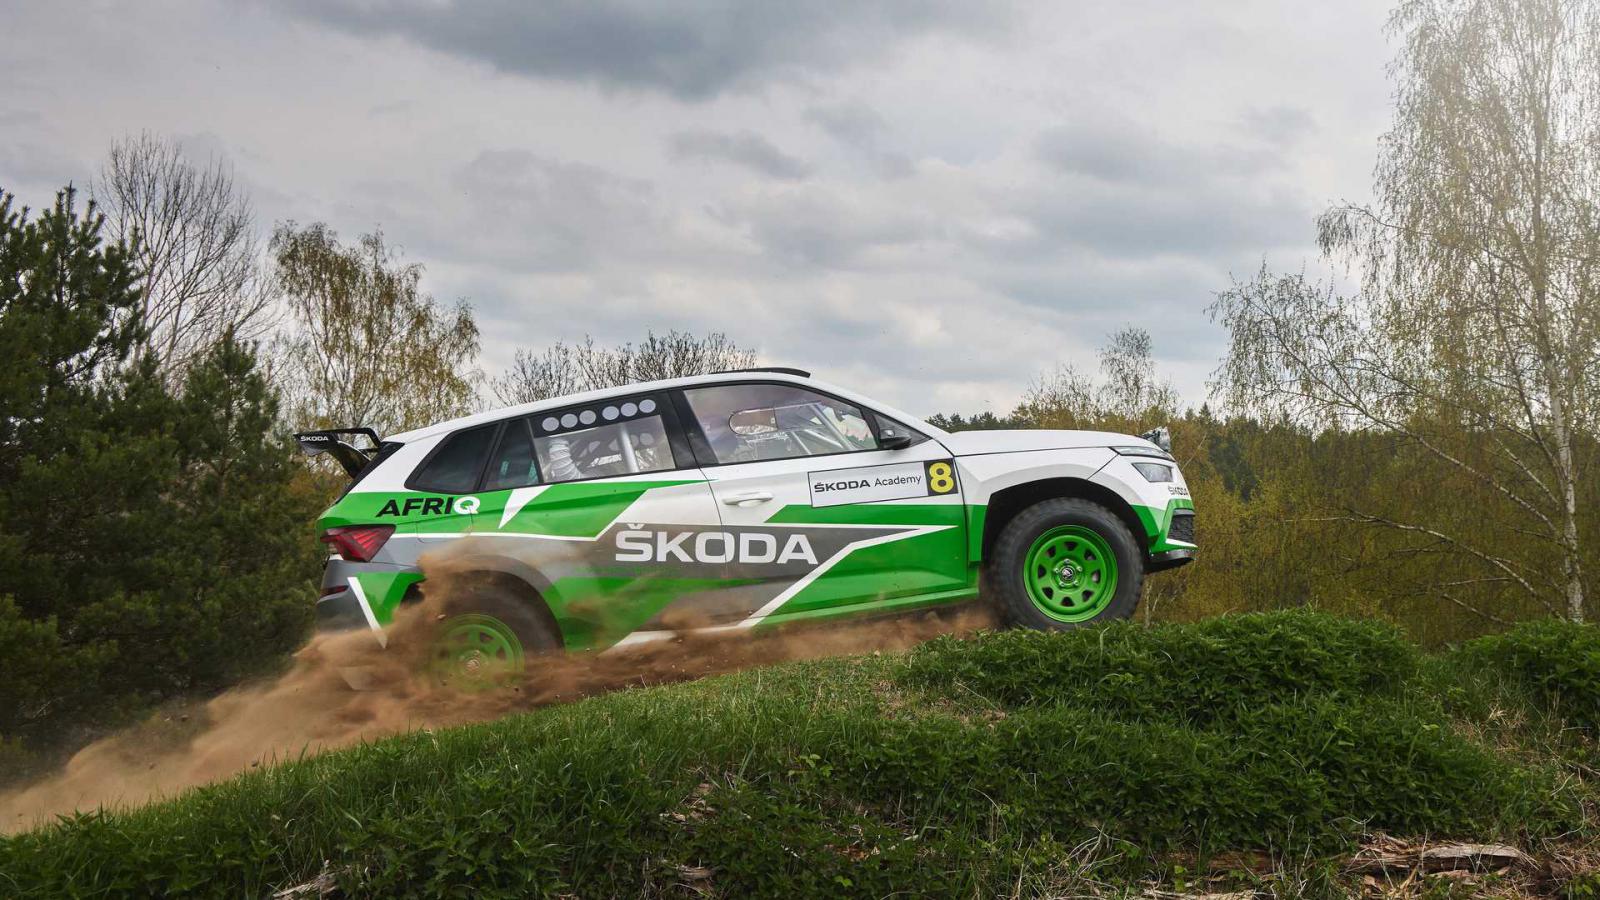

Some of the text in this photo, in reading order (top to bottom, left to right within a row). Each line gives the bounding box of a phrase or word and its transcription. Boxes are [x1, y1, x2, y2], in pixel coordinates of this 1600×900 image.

[814, 475, 922, 492] ŠKODA Academy
[929, 462, 955, 493] 8
[375, 496, 481, 518] AFRIQ
[615, 523, 819, 565] ŠKODA
